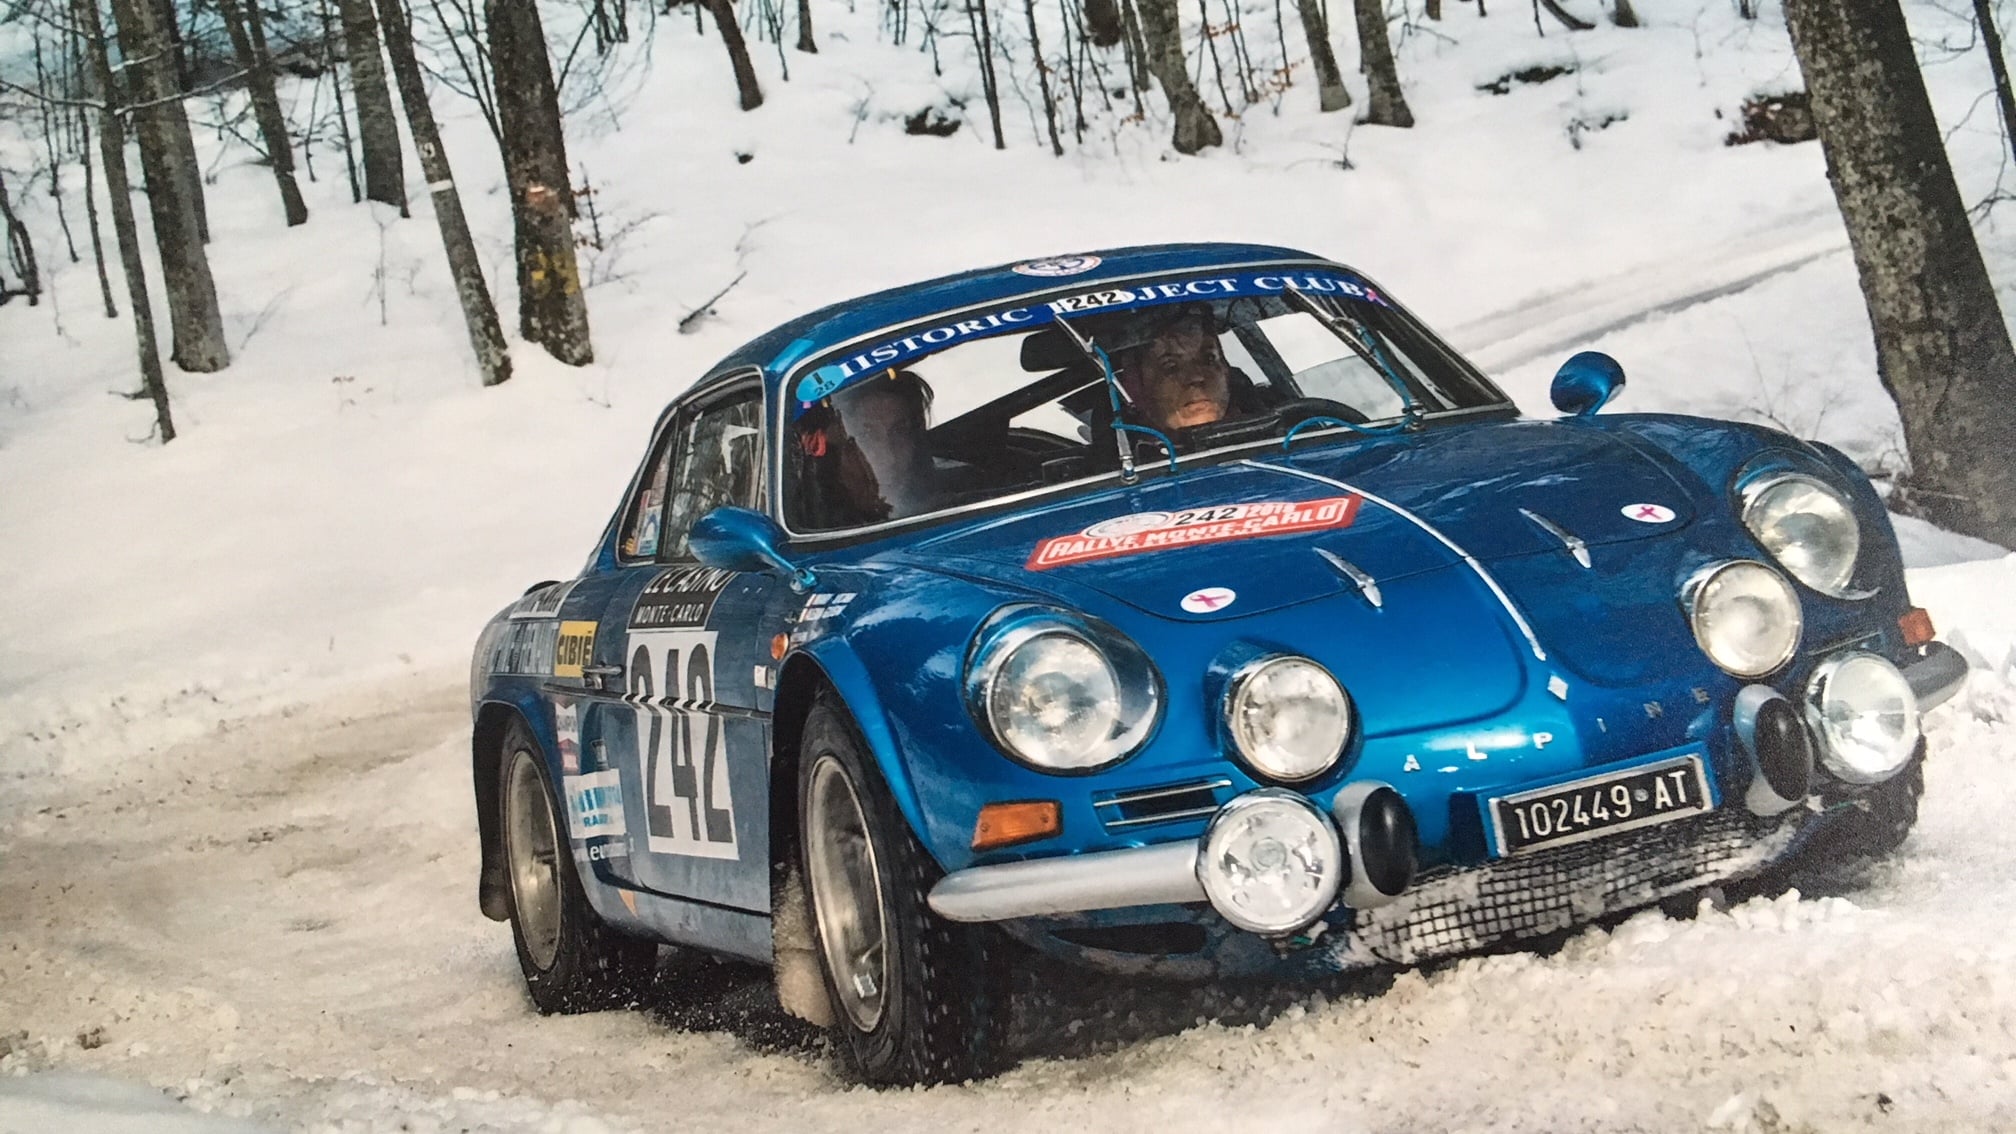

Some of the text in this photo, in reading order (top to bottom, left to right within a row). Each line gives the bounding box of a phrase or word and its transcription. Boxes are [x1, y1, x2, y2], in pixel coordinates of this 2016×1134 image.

[1253, 275, 1365, 297] CLUB
[1066, 291, 1122, 310] 242
[1174, 506, 1239, 526] 242
[1048, 535, 1140, 560] RALLYE
[635, 603, 705, 624] MONTE-CARLO
[1403, 687, 1711, 773] ALPINE
[630, 643, 734, 844] 242
[1514, 770, 1687, 840] 102449 AT
